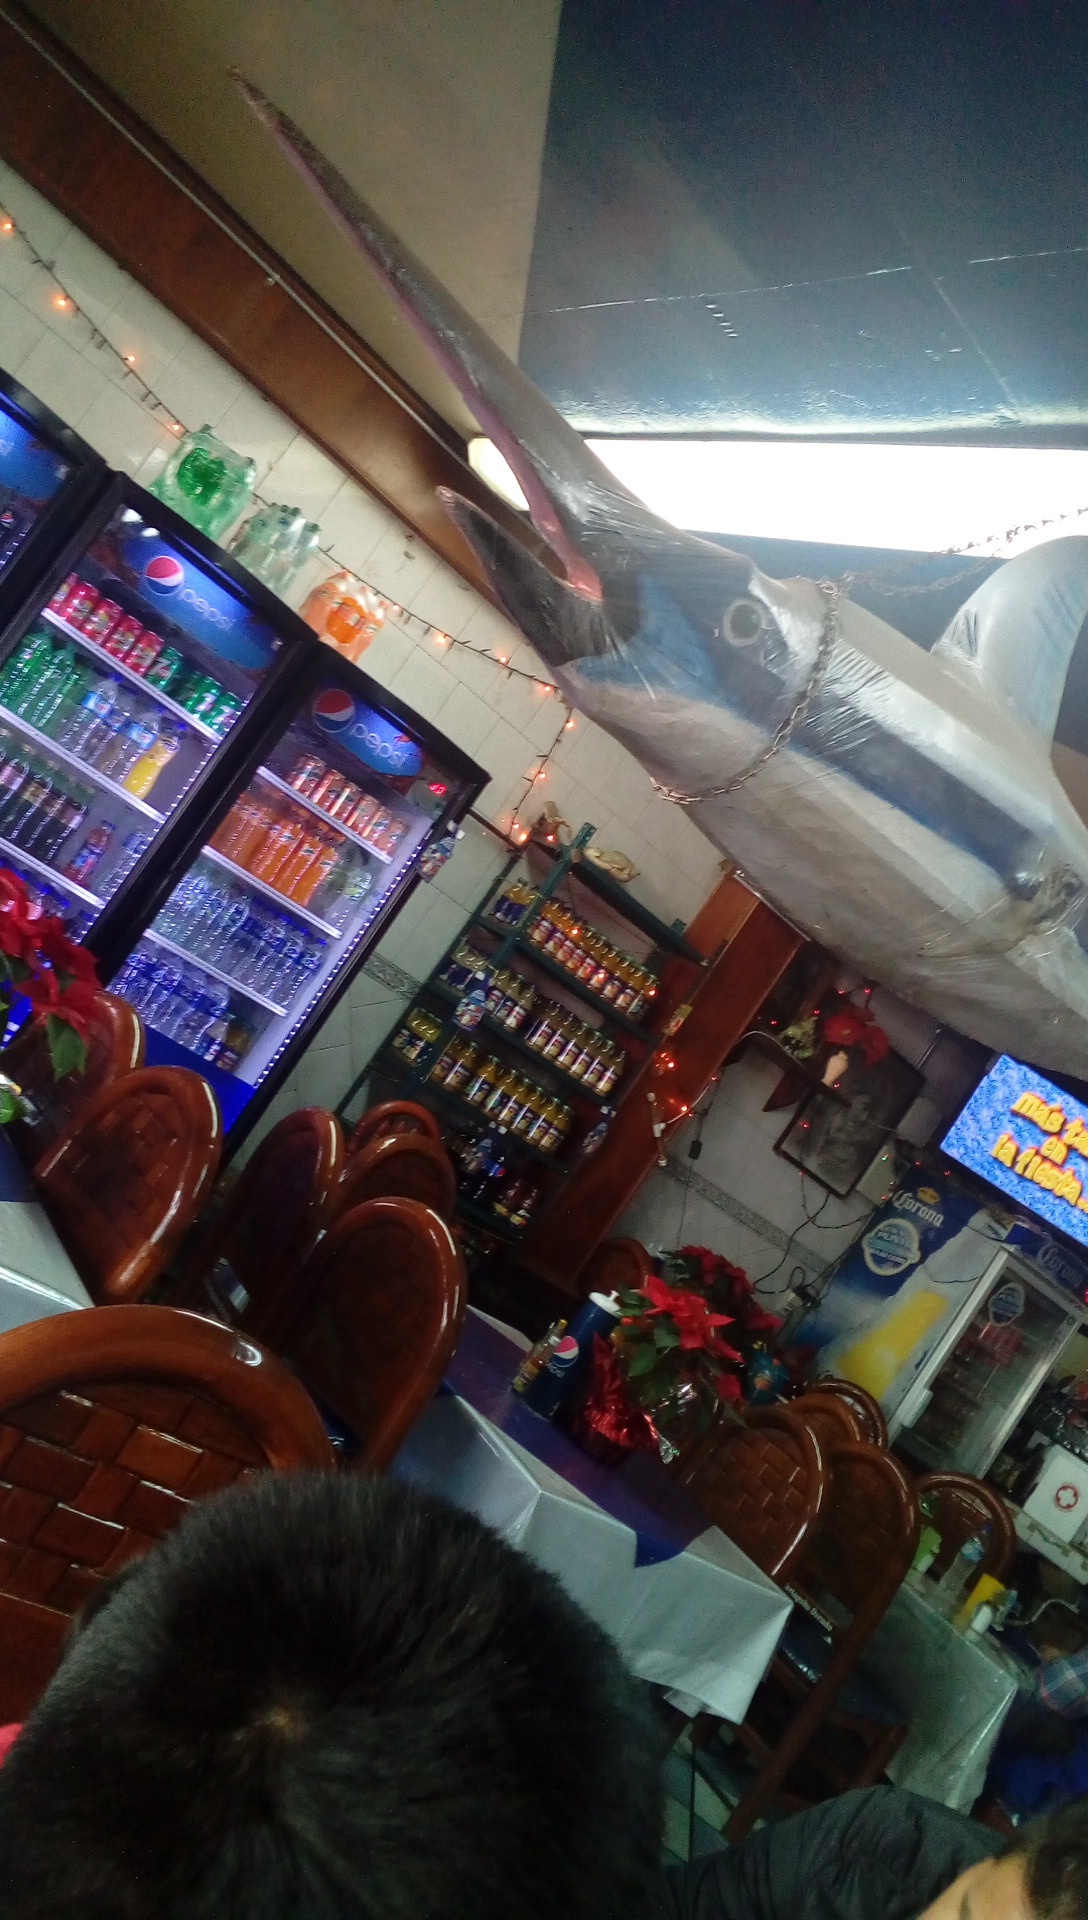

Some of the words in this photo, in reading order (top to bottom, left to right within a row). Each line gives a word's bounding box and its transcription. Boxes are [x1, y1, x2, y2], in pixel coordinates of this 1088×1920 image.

[178, 588, 236, 633] pepsi
[349, 723, 407, 768] pepsi
[991, 1133, 1019, 1168] la
[1041, 1136, 1069, 1166] en
[892, 1190, 944, 1227] Corona
